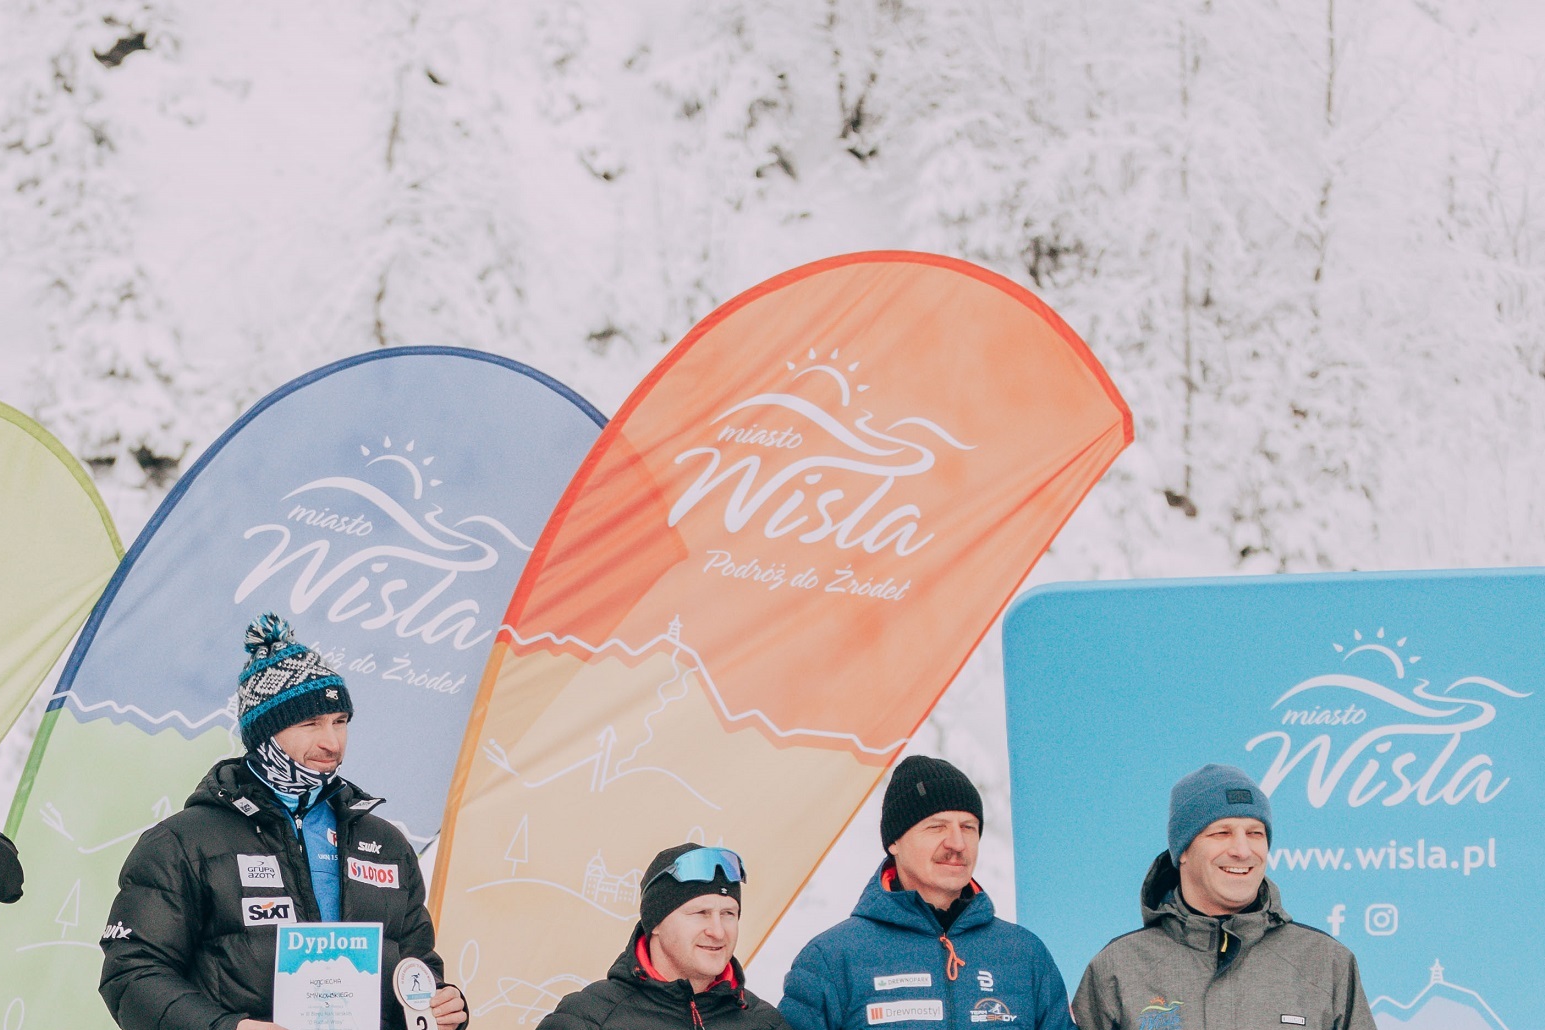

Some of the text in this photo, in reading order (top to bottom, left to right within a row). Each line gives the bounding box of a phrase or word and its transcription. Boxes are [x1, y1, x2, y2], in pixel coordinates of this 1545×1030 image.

[716, 422, 803, 450] miasto
[287, 503, 374, 538] miasto
[703, 550, 786, 591] Podróż
[790, 568, 817, 590] do
[349, 653, 377, 675] do
[1281, 703, 1367, 725] miasto
[361, 864, 394, 884] LOTOS
[287, 931, 368, 954] Dyplom
[888, 977, 929, 986] DREWNOPARK
[885, 1006, 941, 1018] Drewnostyl
